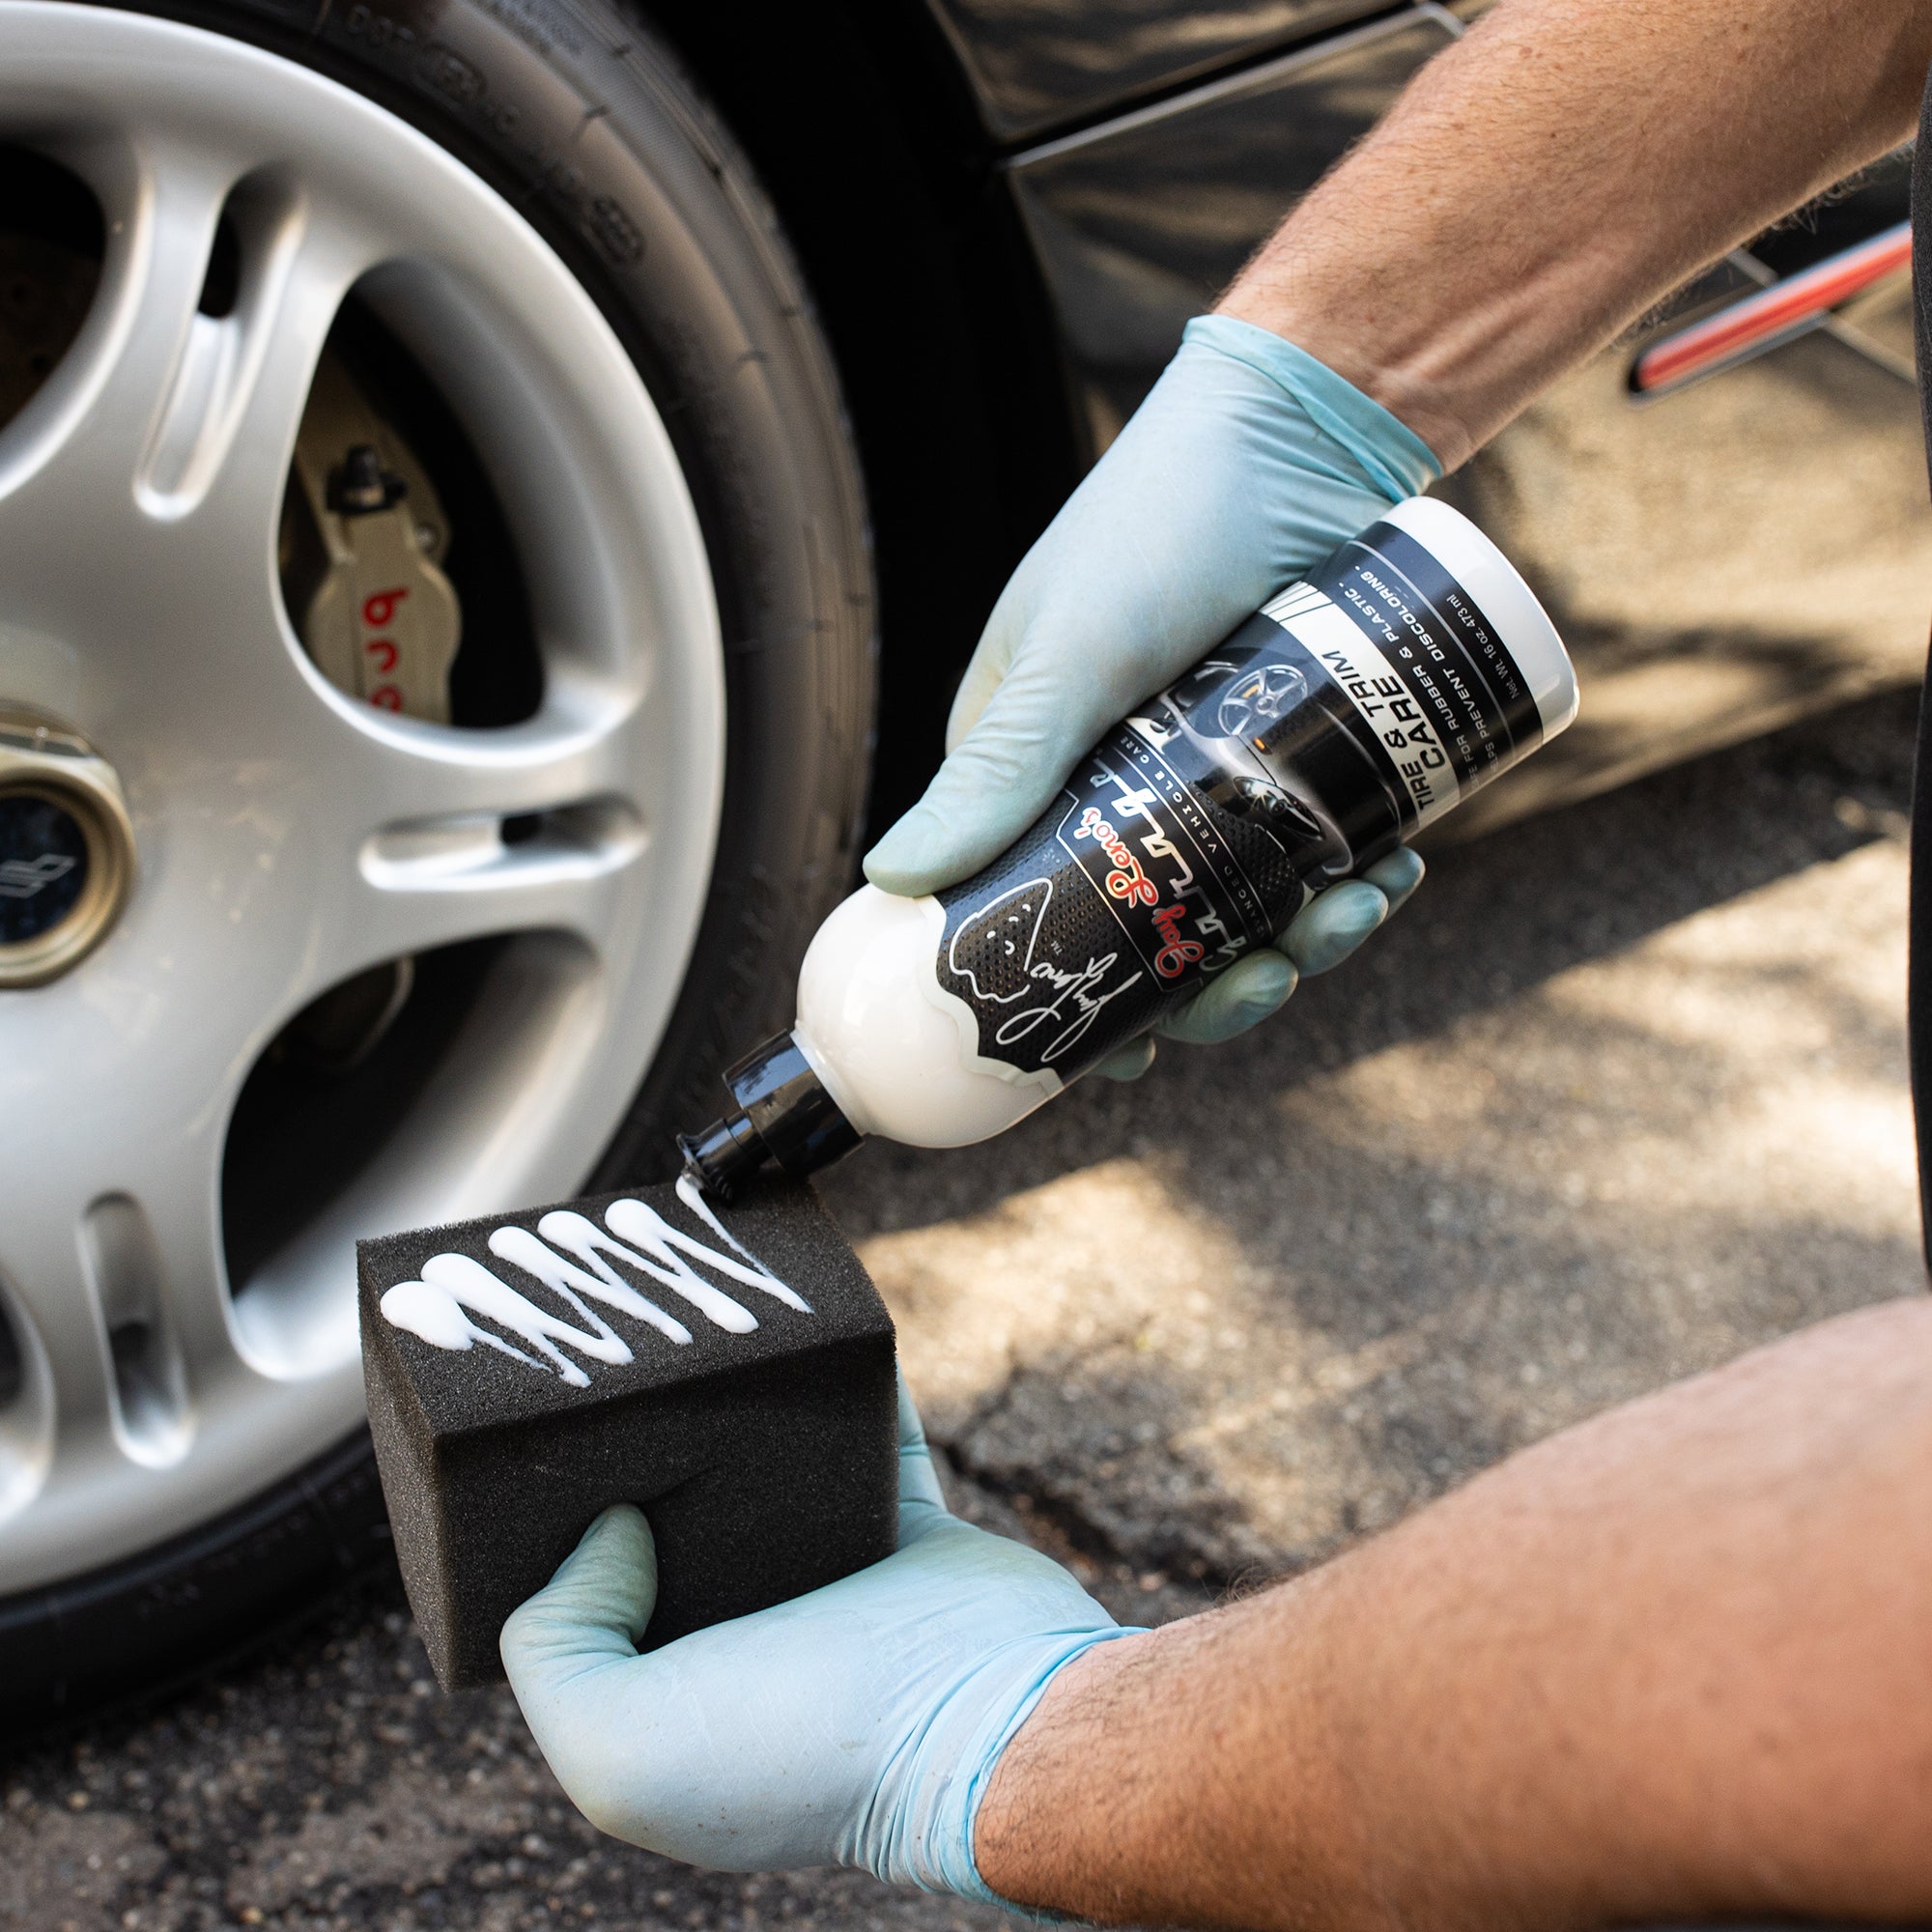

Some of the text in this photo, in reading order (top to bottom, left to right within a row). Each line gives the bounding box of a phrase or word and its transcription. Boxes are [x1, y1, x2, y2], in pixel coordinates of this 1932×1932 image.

[1344, 587, 1400, 642] PLASTIC
[1360, 571, 1446, 662] DISCOLORING
[1446, 594, 1462, 609] ml
[1457, 608, 1476, 628] 473
[1399, 645, 1413, 659] &
[1475, 627, 1489, 644] oz.
[1484, 644, 1497, 659] 16
[1495, 658, 1509, 680] Wt.
[1371, 674, 1446, 770] CARE
[1412, 665, 1460, 730] RUBBER
[1443, 668, 1491, 739] PREVENT
[1120, 735, 1151, 764] CARE
[1321, 650, 1435, 810] TIRE & TRIM
[1457, 734, 1474, 763] FOR
[1154, 770, 1217, 854] VEHICLE
[1089, 756, 1247, 972] Garage
[1073, 807, 1205, 979] Jay Leno's
